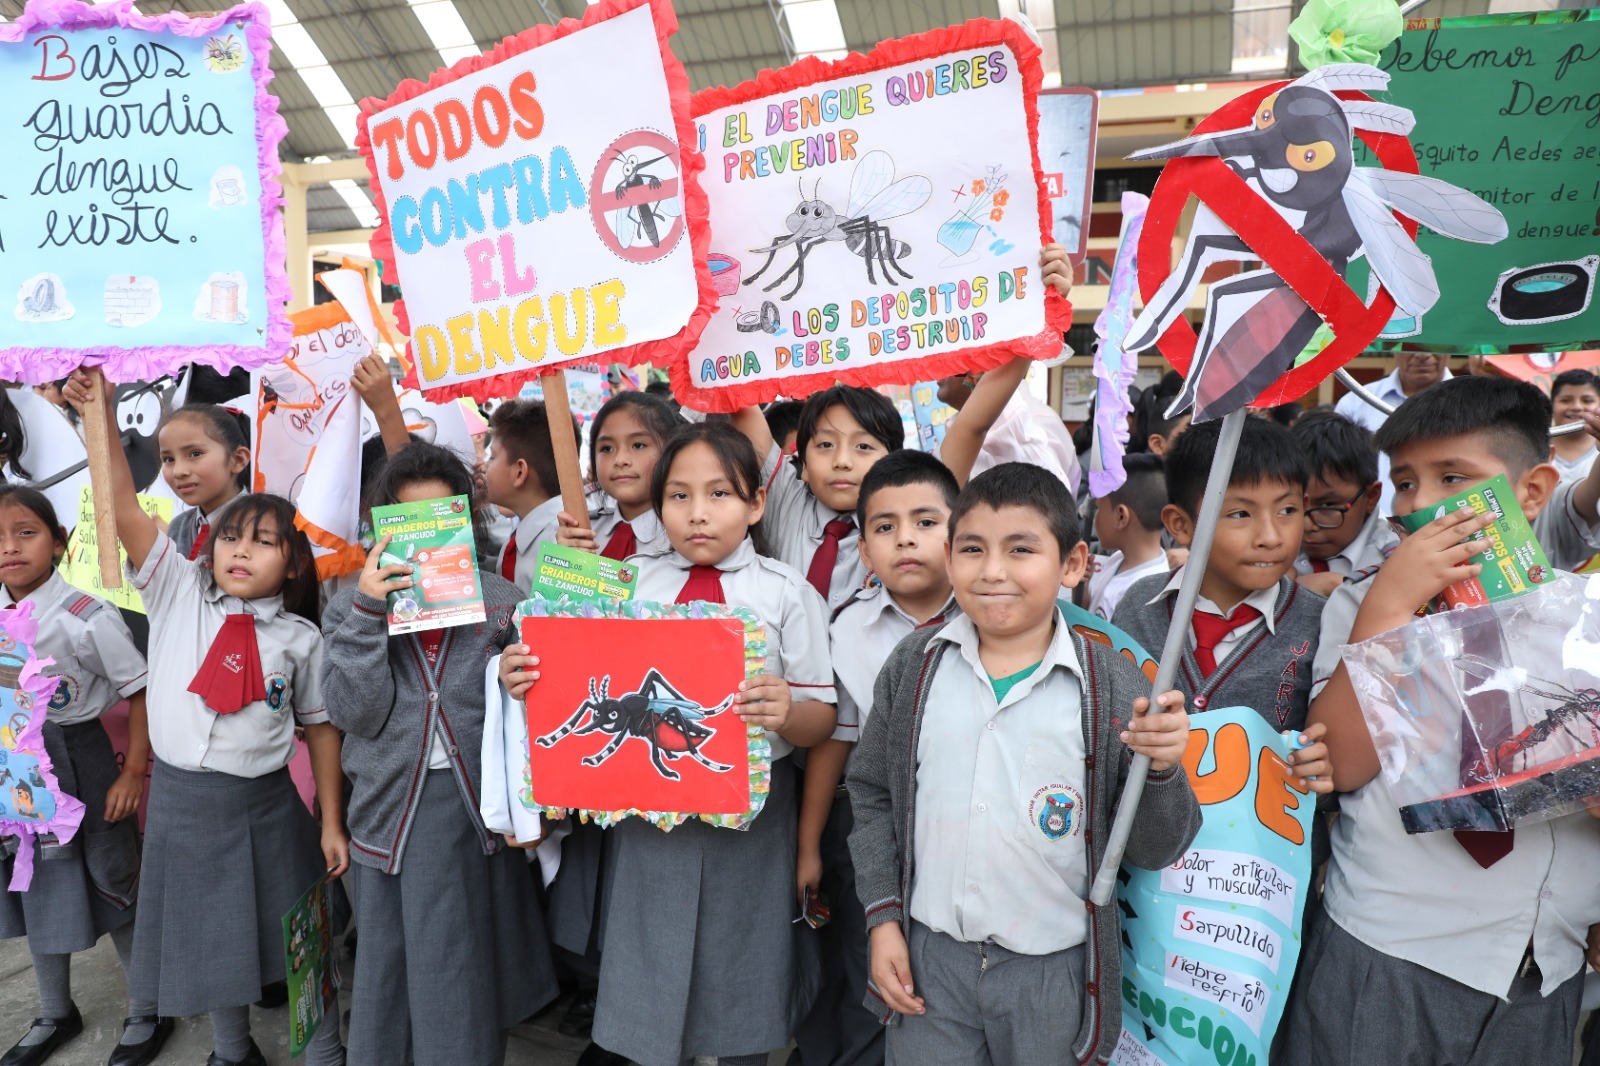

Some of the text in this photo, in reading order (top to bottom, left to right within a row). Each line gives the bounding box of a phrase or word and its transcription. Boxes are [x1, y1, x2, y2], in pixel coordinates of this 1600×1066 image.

[23, 89, 233, 151] guardia
[372, 70, 545, 181] TODOS
[722, 111, 752, 148] EL
[765, 83, 874, 138] DENGUE
[1492, 136, 1563, 162] Aedes
[31, 147, 193, 205] dengue
[1551, 183, 1578, 202] de
[390, 146, 586, 254] CONTRA
[38, 202, 197, 249] existe.
[464, 232, 537, 303] EL
[792, 303, 840, 338] LOS
[999, 266, 1028, 303] DE
[415, 279, 629, 382] DENGUE
[700, 350, 761, 383] AGUA
[775, 337, 851, 370] DEBES
[380, 515, 405, 525] ELIMINA
[1483, 488, 1504, 519] ELIMINA
[380, 521, 436, 536] CRIADEROS
[399, 530, 436, 543] ZANCUDO
[540, 565, 598, 588] CRIADEROS
[544, 555, 569, 568] ELIMINA
[539, 575, 554, 587] DEL
[555, 580, 594, 597] ZANCUDO
[1183, 875, 1276, 901] y muscular
[1232, 861, 1293, 896] articular
[1180, 911, 1275, 958] Sarpullido
[1244, 981, 1266, 1006] sin
